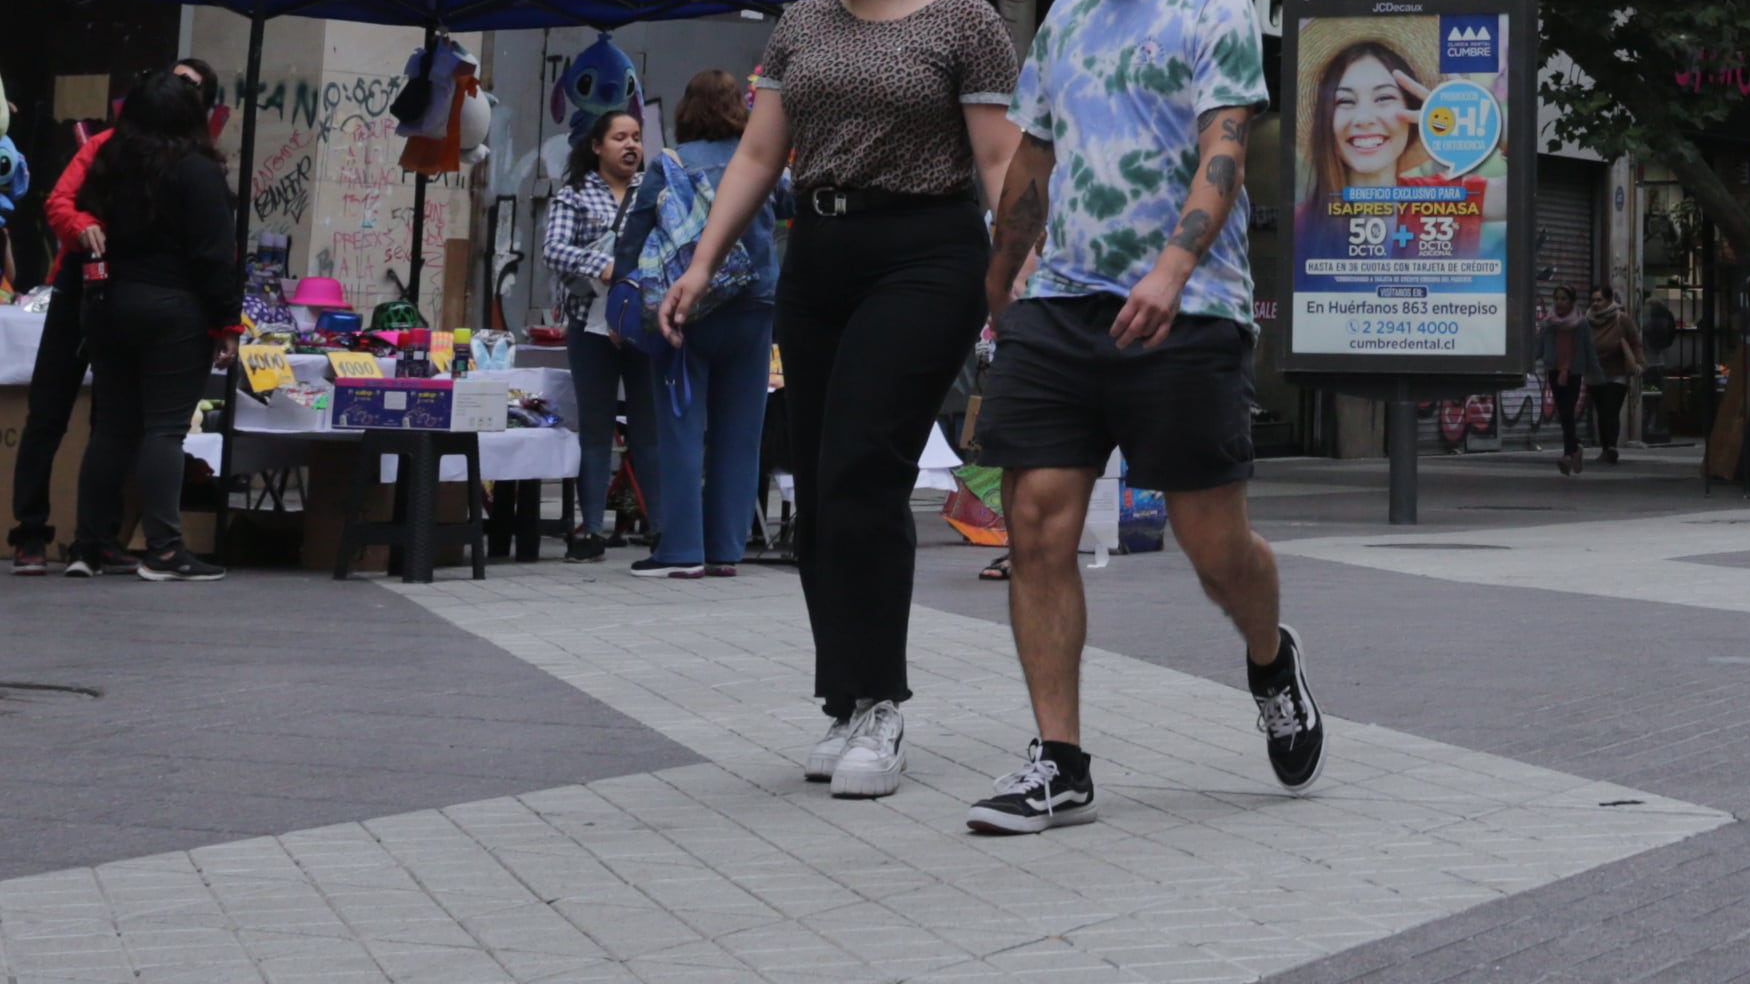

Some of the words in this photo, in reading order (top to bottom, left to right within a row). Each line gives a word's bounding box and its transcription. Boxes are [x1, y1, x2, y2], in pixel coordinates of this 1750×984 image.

[1373, 2, 1423, 13] JCDecaux
[1447, 47, 1491, 57] CUMBRE
[1349, 188, 1391, 200] BENEFICIO
[1392, 188, 1437, 199] EXCLUSIVO
[1439, 187, 1461, 199] PARA
[1328, 202, 1393, 216] ISAPRES
[1394, 202, 1407, 215] Y
[1411, 202, 1479, 215] FONASA
[1349, 245, 1387, 257] DCTO.
[1418, 240, 1453, 251] DCTO.
[1308, 262, 1334, 273] HASTA
[1336, 262, 1347, 273] EN
[1361, 262, 1391, 273] CUOTAS
[1394, 262, 1410, 273] CON
[1412, 262, 1446, 273] TARJETA
[1447, 262, 1459, 273] DE
[1306, 301, 1324, 314] En
[1328, 300, 1399, 315] Huérfanos
[1402, 301, 1428, 315] 863
[1432, 301, 1498, 317] entrepiso
[1362, 322, 1371, 334] 2
[1376, 321, 1412, 334] 2941
[1417, 322, 1459, 335] 4000
[1349, 338, 1456, 350] cumbredental.cl
